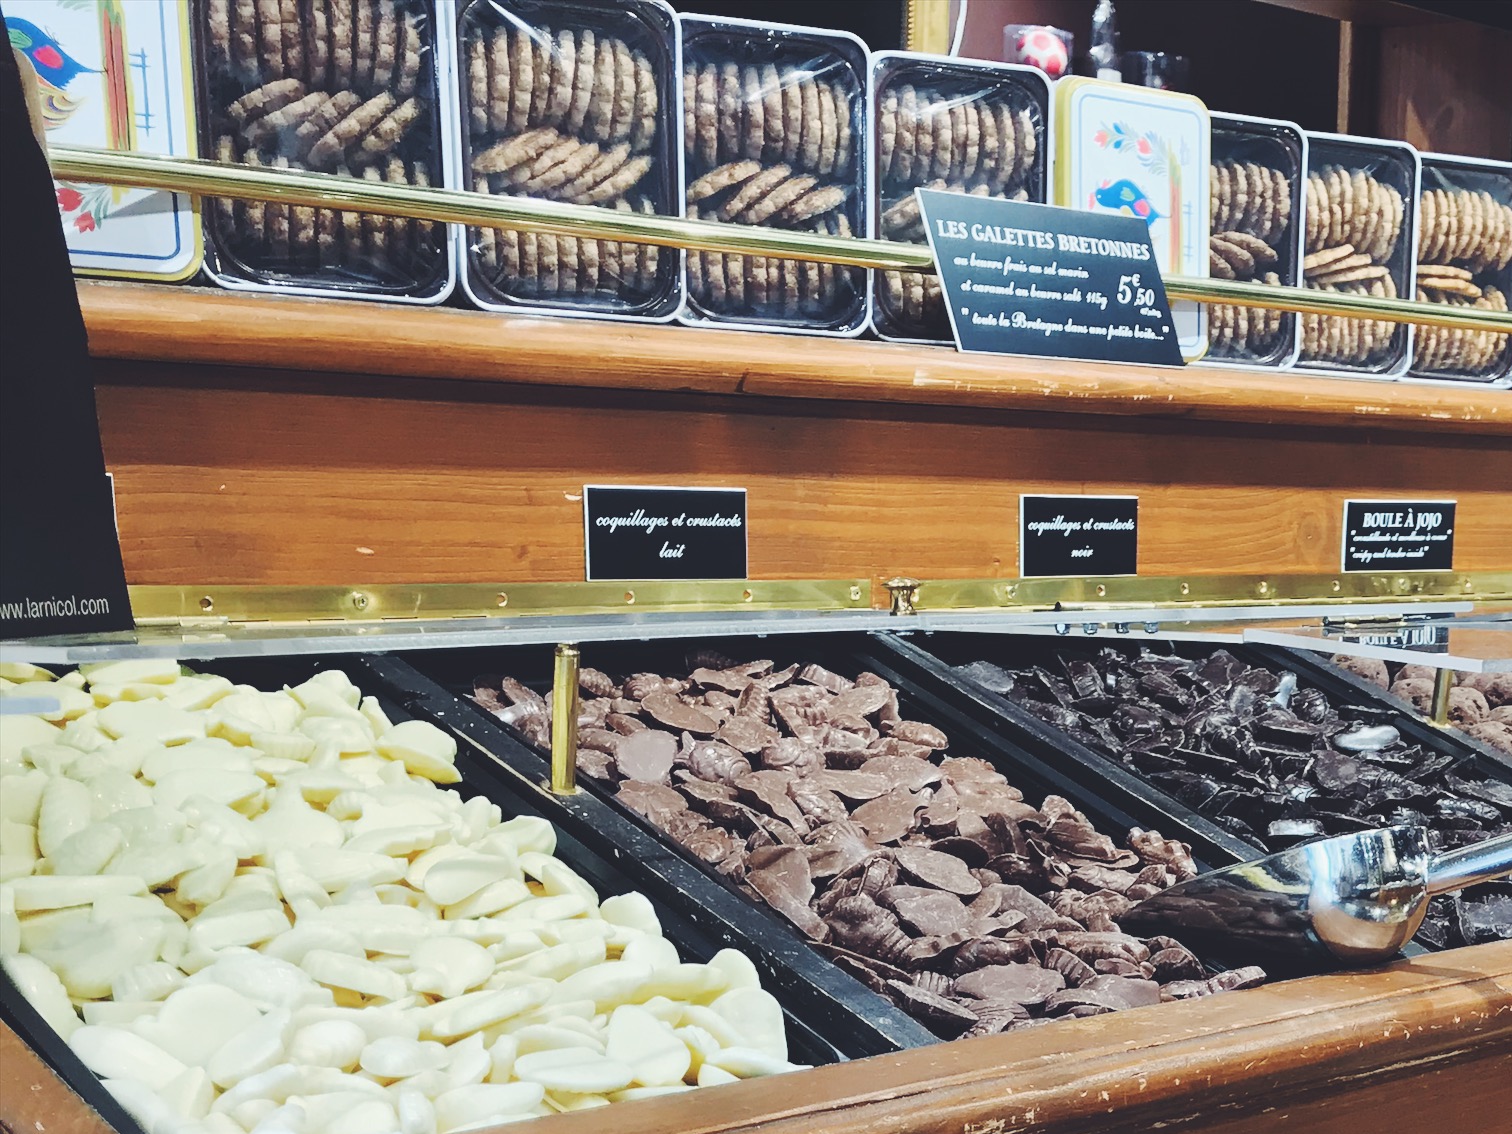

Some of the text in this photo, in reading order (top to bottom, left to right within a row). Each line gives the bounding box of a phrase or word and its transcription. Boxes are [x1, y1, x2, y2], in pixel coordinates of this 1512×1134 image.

[936, 219, 1151, 261] LES GALETTES BRETONNES
[970, 253, 1003, 270] beurre
[1002, 256, 1028, 276] frais
[1044, 262, 1057, 276] sel
[1057, 267, 1090, 279] marin
[960, 279, 971, 292] et
[972, 281, 1014, 296] caramel
[1030, 284, 1062, 301] beurre
[998, 311, 1011, 327] la
[1012, 311, 1063, 336] Bretagne
[1064, 318, 1088, 335] dans
[1107, 324, 1134, 341] petite
[596, 508, 742, 534] coquillages et crustacés
[1028, 515, 1135, 537] coquillages et crustacés
[1362, 508, 1443, 531] BOULE À JOJO
[659, 541, 686, 558] lait
[1071, 545, 1094, 558] noir
